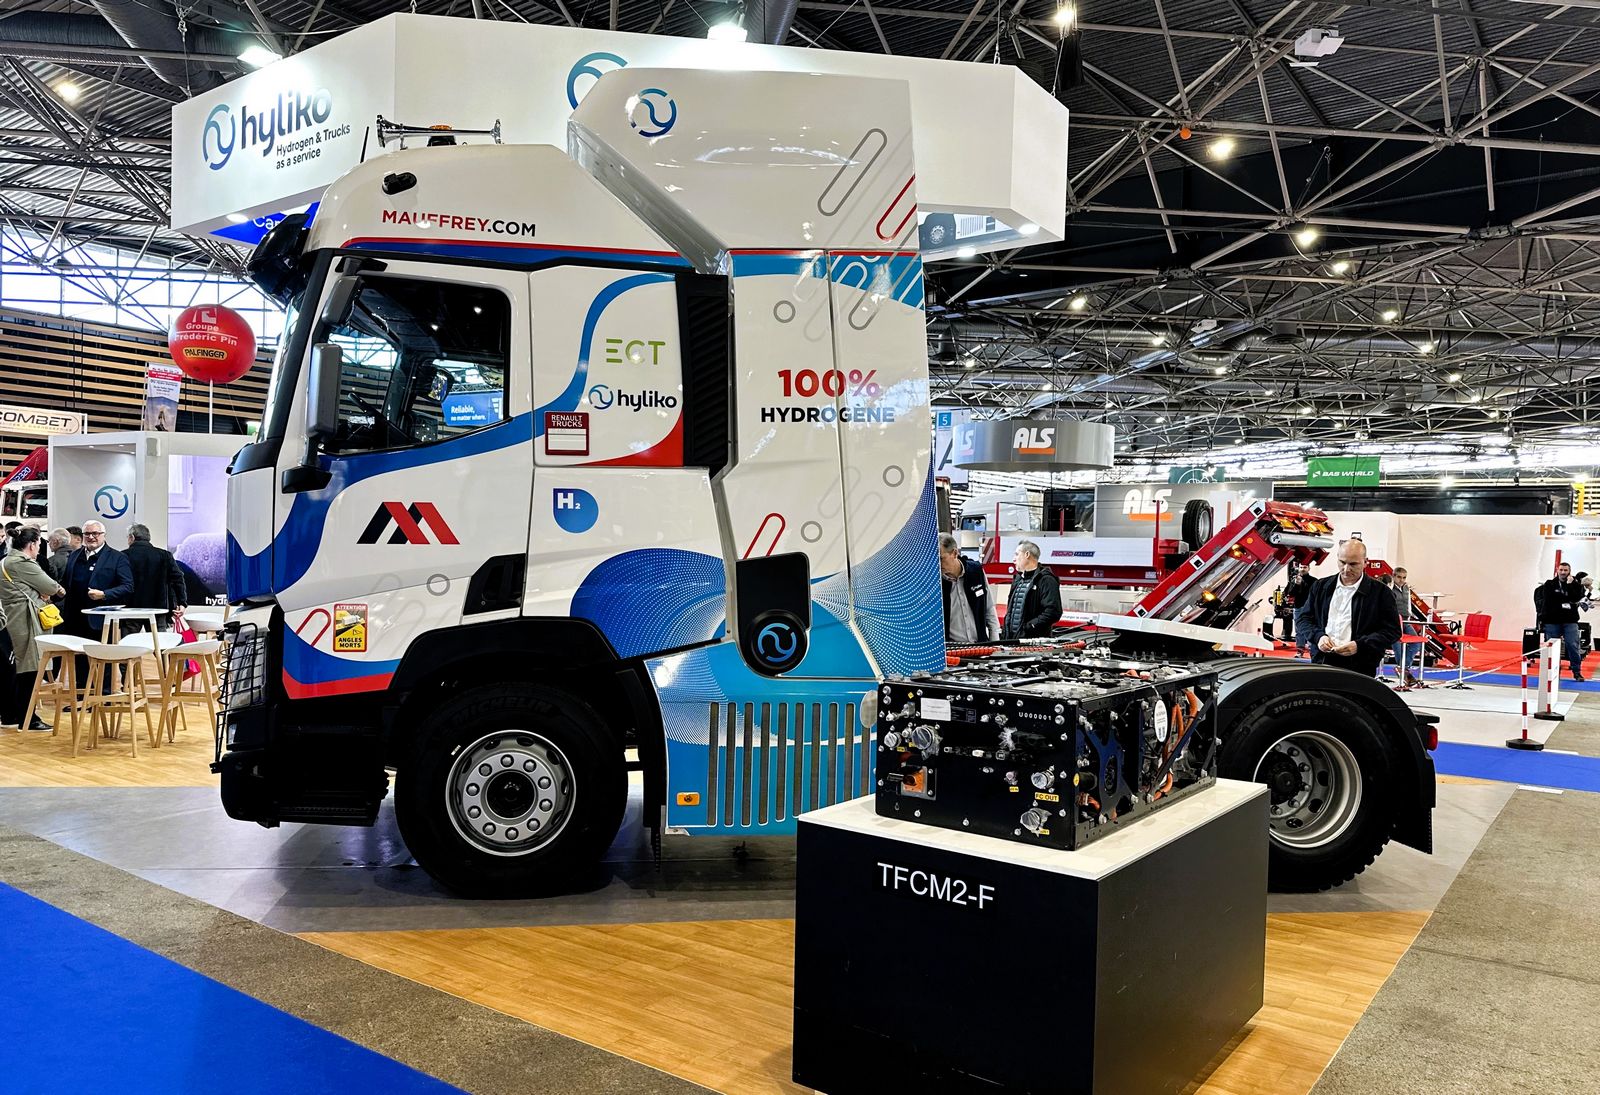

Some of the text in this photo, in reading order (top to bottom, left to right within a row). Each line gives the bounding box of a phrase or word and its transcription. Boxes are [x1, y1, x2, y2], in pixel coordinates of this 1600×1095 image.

[241, 88, 332, 157] hyliko
[276, 123, 351, 156] Hydrogen & Trucks
[276, 146, 321, 170] as a service
[382, 210, 536, 237] MAUFFREY.COM
[185, 322, 220, 332] Groupe
[220, 335, 238, 347] Pin
[606, 338, 666, 365] ECT
[184, 348, 225, 359] PALFINGER
[777, 368, 880, 398] 100%
[450, 404, 475, 414] Reliable,
[617, 389, 678, 413] hyliko
[551, 414, 583, 422] RENAULT
[760, 403, 895, 423] HYDROGÈNE
[942, 416, 948, 426] 5
[551, 420, 583, 428] TRUCKS
[1013, 427, 1056, 449] ALS
[1122, 488, 1173, 514] ALS
[1539, 523, 1567, 536] HC
[337, 636, 363, 644] ANGLES
[877, 861, 995, 909] TFCM2-F
